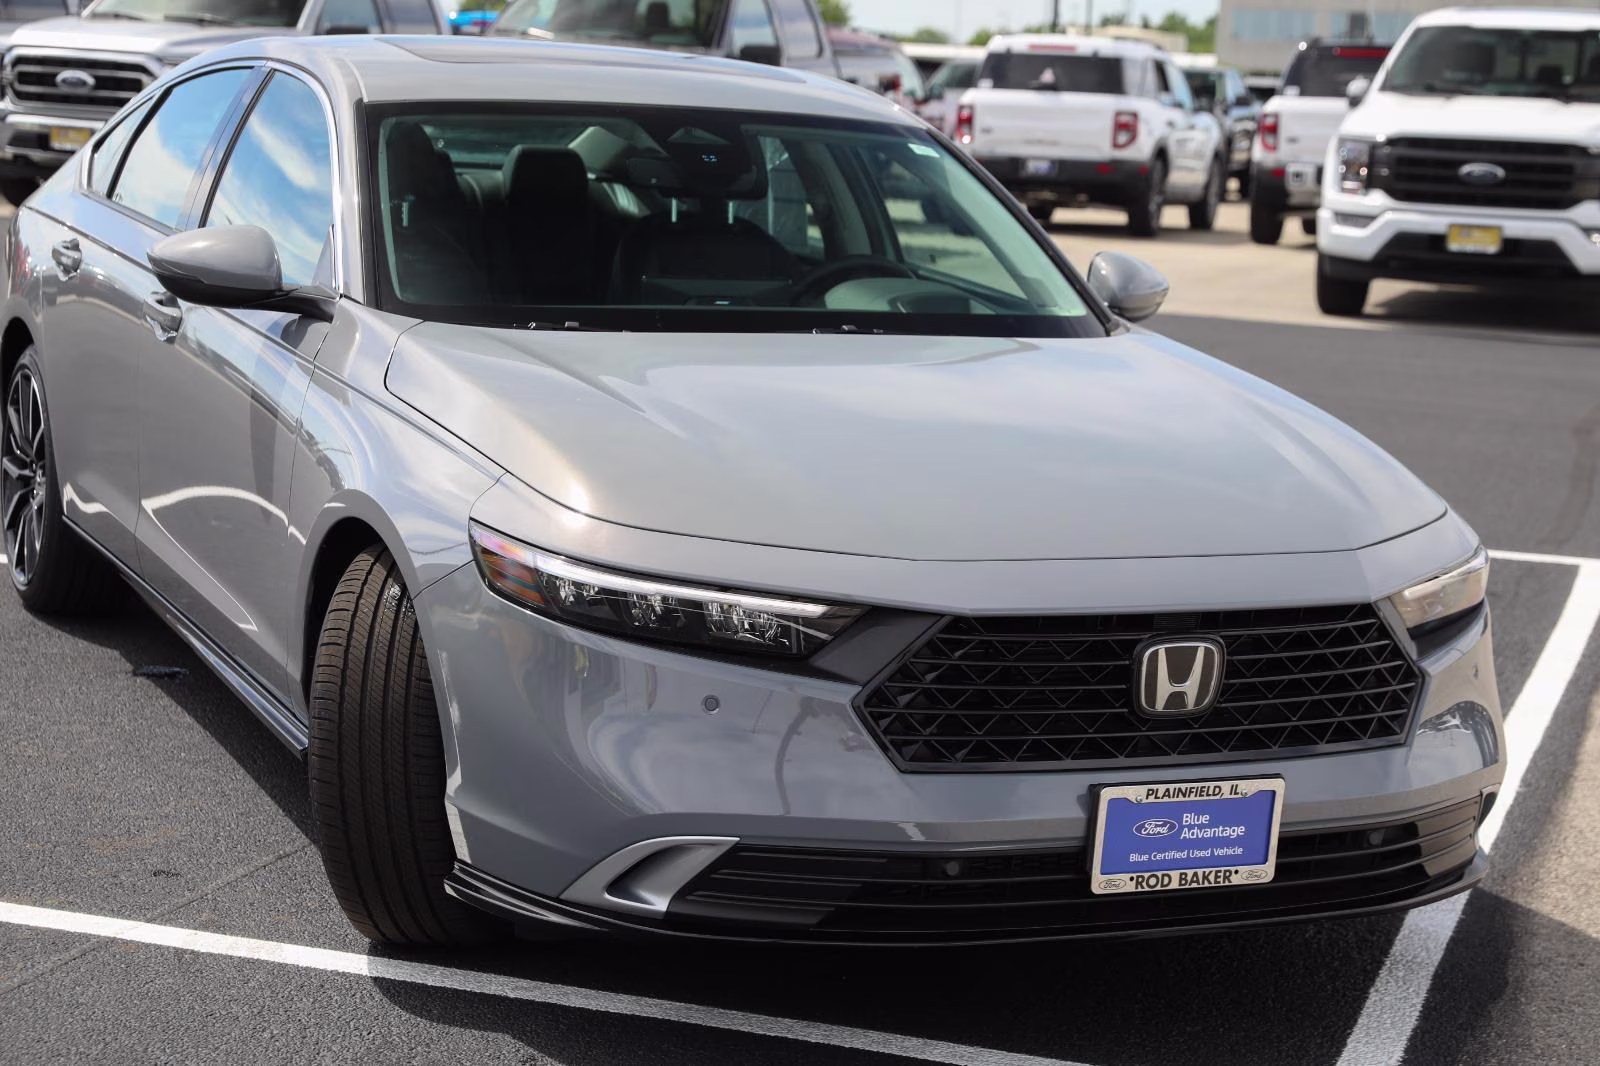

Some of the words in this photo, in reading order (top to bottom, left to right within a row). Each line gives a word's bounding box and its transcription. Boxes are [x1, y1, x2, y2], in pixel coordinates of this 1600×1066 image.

[1145, 785, 1224, 800] PLAINFIELD,
[1229, 784, 1240, 796] IL
[1182, 812, 1210, 825] Blue
[1141, 821, 1171, 835] Ford
[1180, 825, 1245, 840] Advantage
[1129, 853, 1149, 862] Blue
[1151, 850, 1187, 860] Certified
[1189, 848, 1212, 858] Used
[1213, 846, 1244, 856] Vehicle
